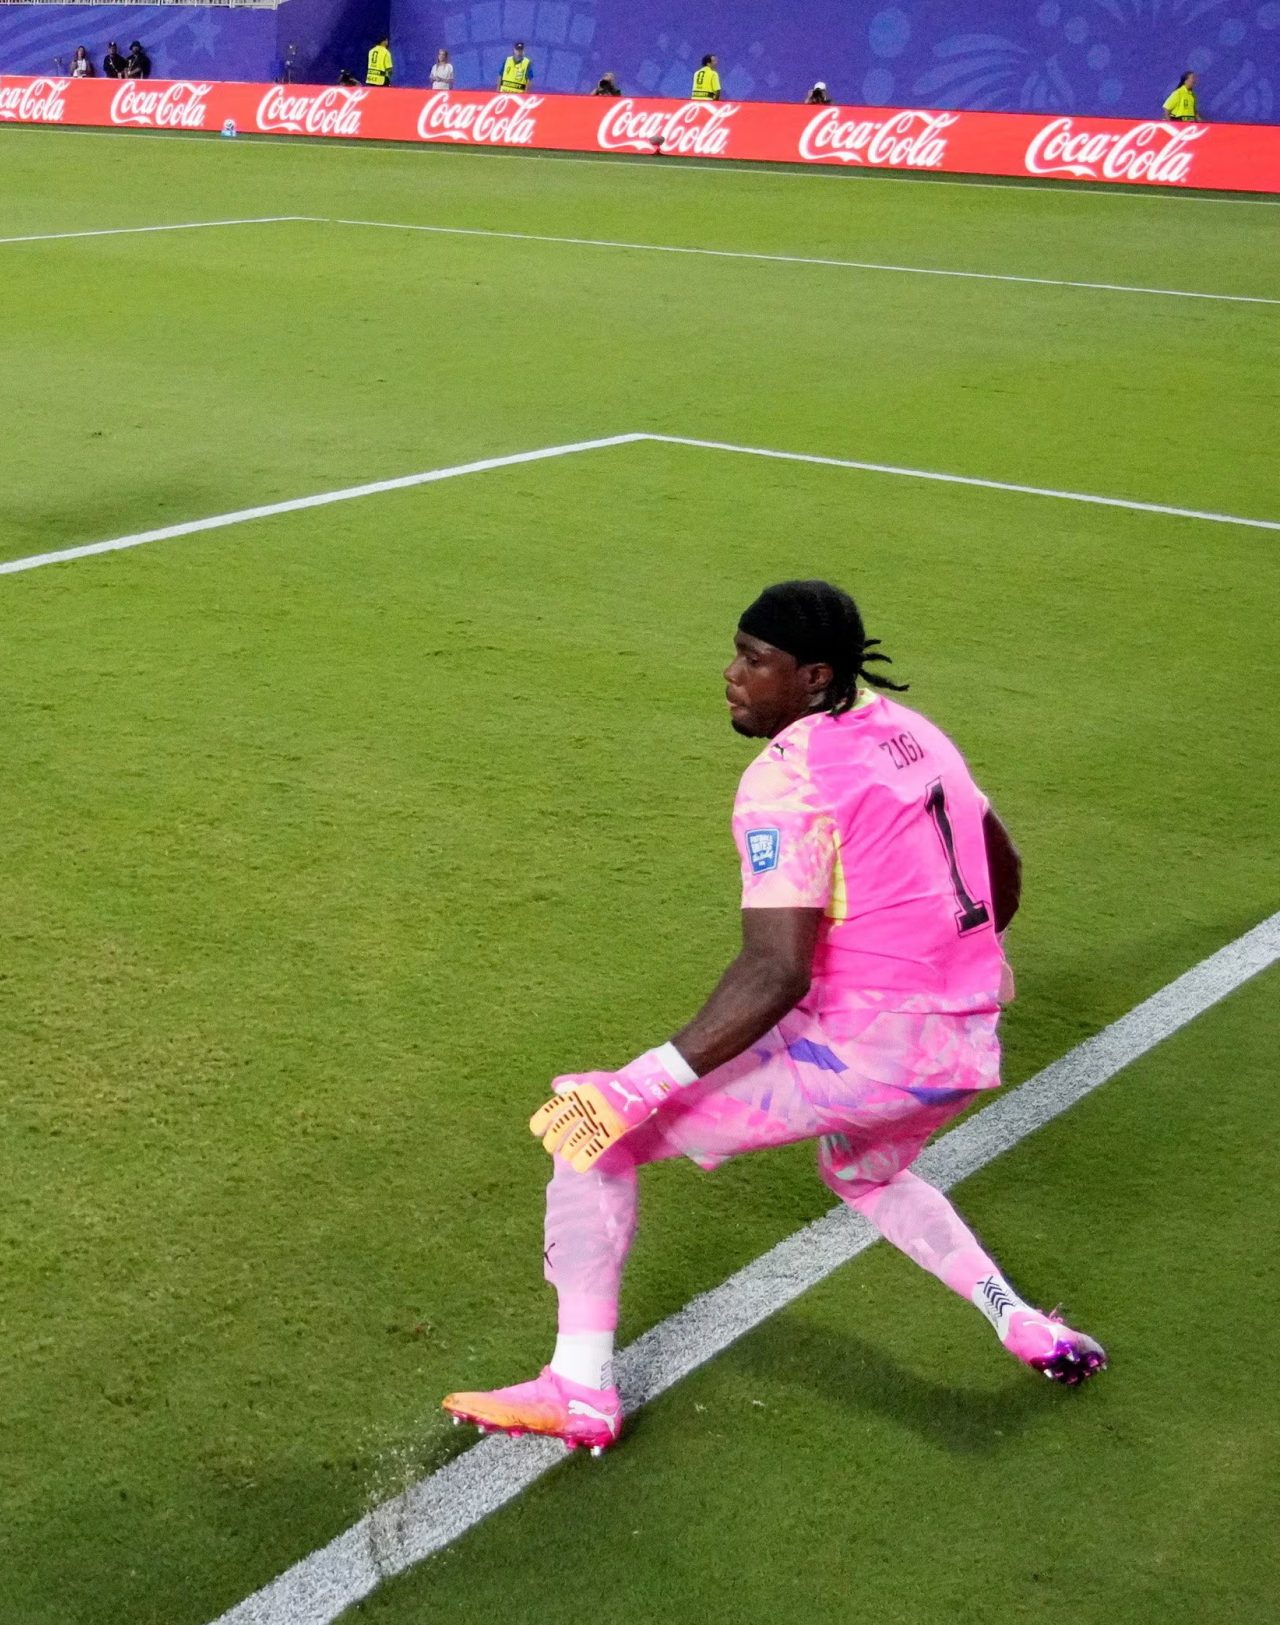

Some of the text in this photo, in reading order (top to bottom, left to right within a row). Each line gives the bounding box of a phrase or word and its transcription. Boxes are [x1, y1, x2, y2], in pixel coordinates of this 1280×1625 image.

[109, 80, 214, 128] Coca-Cola
[255, 84, 370, 135] Coca-Cola
[416, 88, 545, 144] Coca-Cola
[596, 98, 741, 155] Coca-Cola
[798, 106, 959, 167] Coca-Cola
[1024, 117, 1208, 183] Coca-Cola
[878, 731, 925, 770] ZIGI
[924, 775, 994, 938] 1
